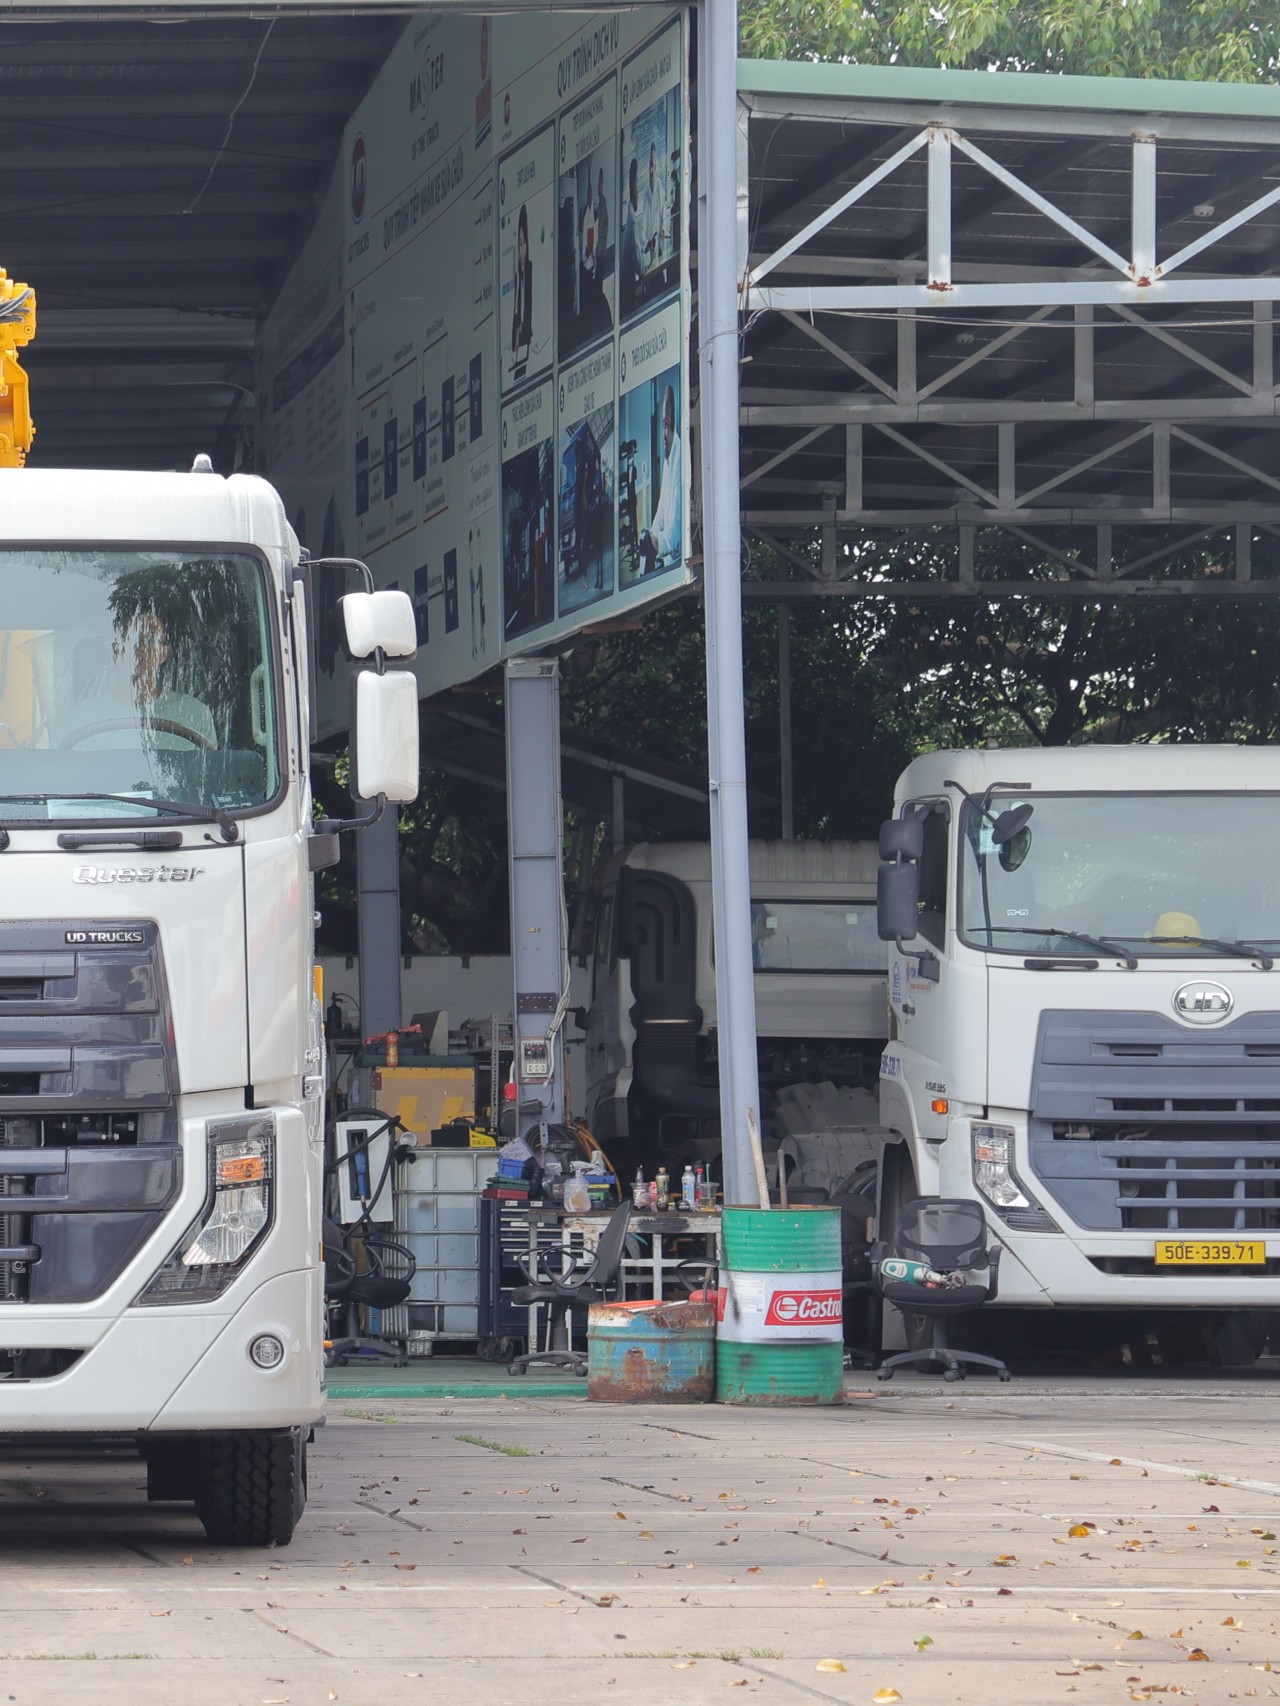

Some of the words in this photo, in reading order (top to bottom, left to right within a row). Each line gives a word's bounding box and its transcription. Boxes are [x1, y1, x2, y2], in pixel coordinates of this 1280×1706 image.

[557, 54, 573, 98] QUY
[72, 865, 206, 885] Quester
[66, 932, 87, 942] UD
[88, 932, 143, 942] TRUCKS
[1178, 992, 1229, 1012] UD
[1164, 1245, 1254, 1260] 50E-339.71
